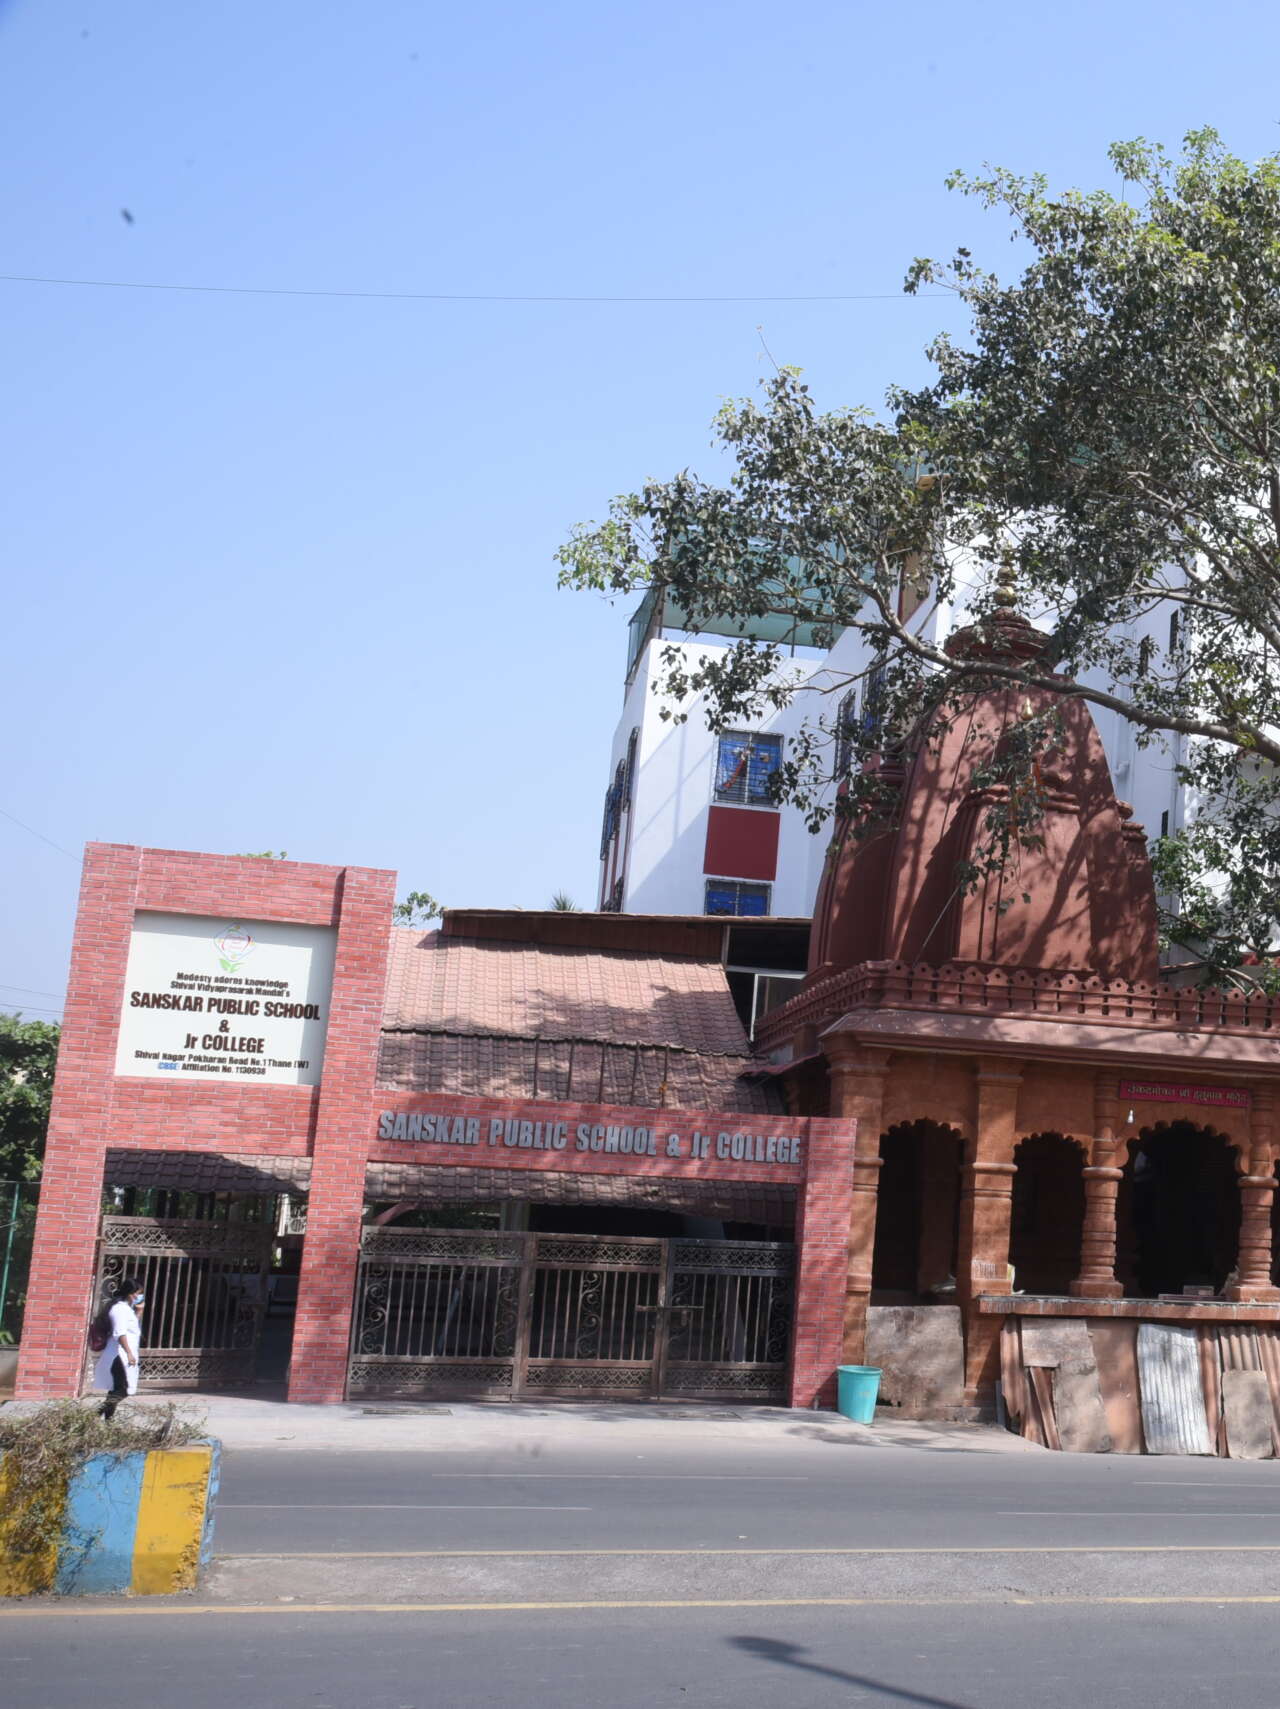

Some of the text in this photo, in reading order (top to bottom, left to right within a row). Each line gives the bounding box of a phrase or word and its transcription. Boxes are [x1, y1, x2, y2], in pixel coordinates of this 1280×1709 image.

[177, 972, 289, 989] Modesty adorns knowledge
[130, 991, 321, 1021] SANSKAR PUBLIC SCHOOL
[219, 1019, 230, 1033] &
[184, 1033, 265, 1053] Jr COLLEGE
[162, 1053, 186, 1063] Nagar
[188, 1054, 227, 1064] Pokharan
[228, 1056, 248, 1065] Road
[181, 1063, 220, 1073] Affiliation
[378, 1110, 801, 1164] SANSKAR PUBLIC SCHOOL & Jr COLLEGE
